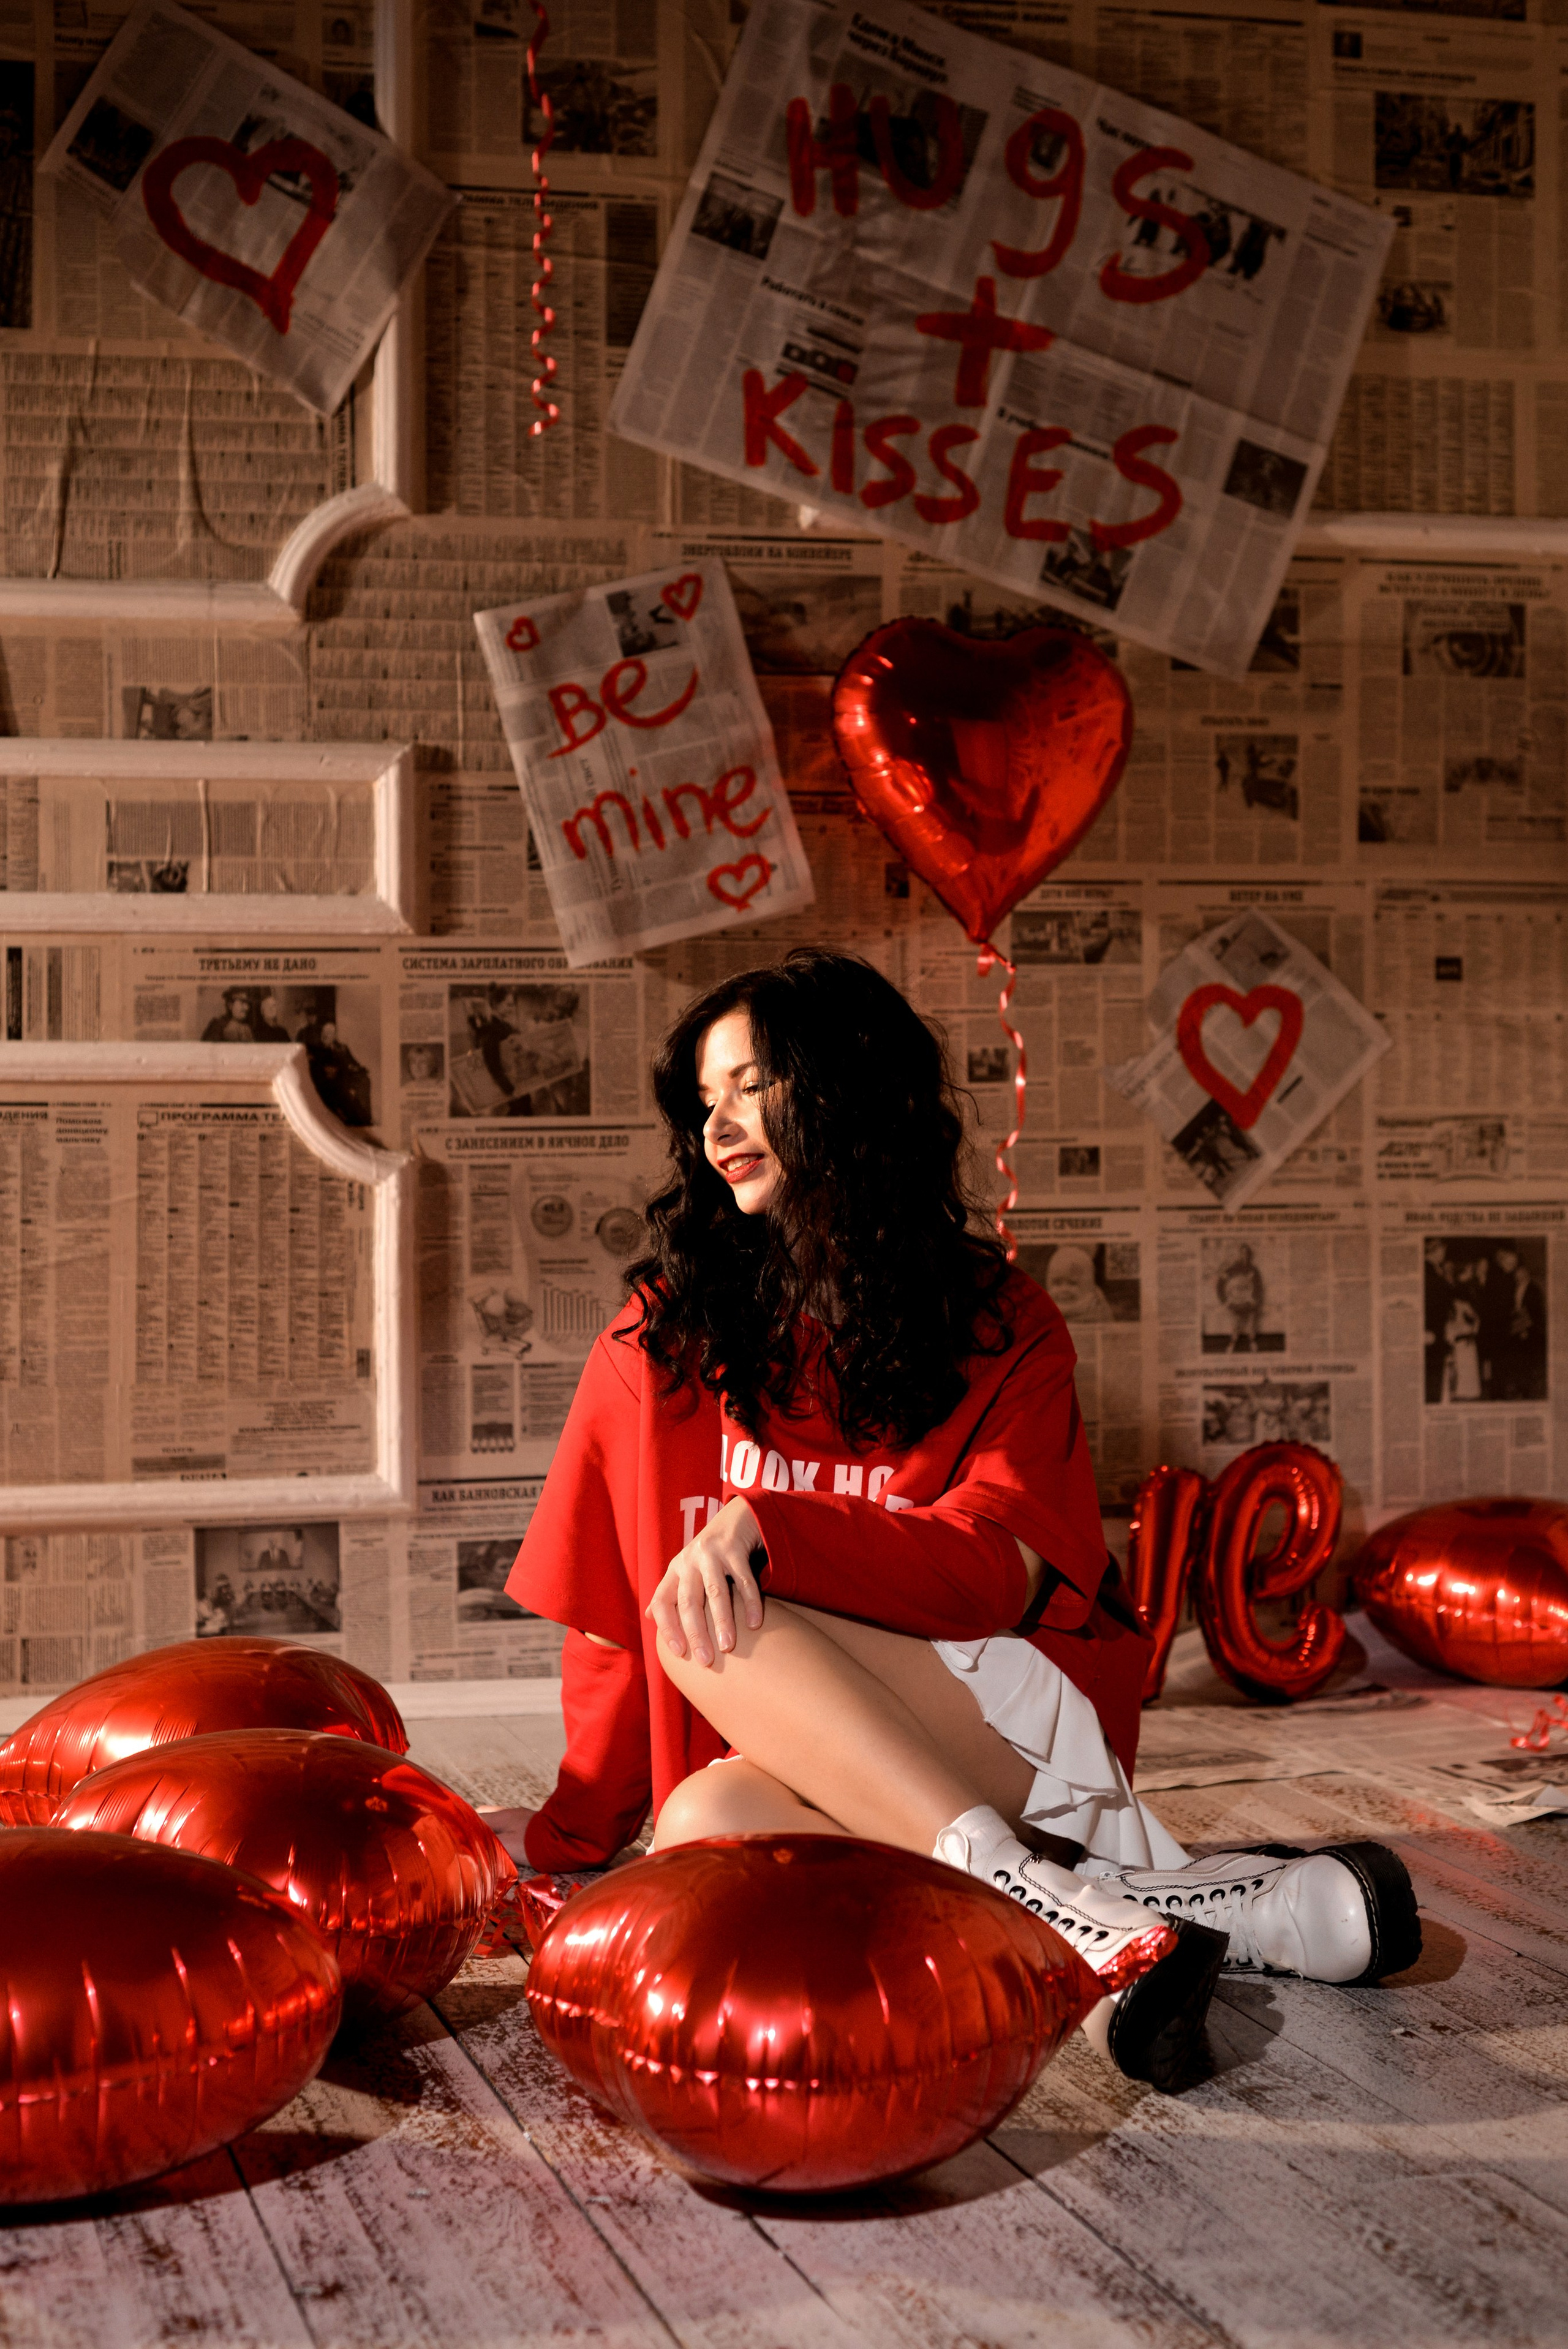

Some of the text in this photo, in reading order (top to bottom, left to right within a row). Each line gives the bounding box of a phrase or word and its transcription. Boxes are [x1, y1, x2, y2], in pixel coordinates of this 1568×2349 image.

[562, 764, 773, 861] mine
[198, 958, 317, 971] ТРЕТЬЕМУ НЕ ДАНО
[402, 957, 457, 970] СИСТЕМА
[460, 957, 546, 970] ЗАРПЛАТНОГО
[160, 1112, 260, 1122] ПРОГРАММА
[445, 1138, 453, 1150] С
[455, 1137, 534, 1150] ЗАНЕСЕНИЕМ
[538, 1137, 545, 1148] В
[598, 1135, 630, 1148] ДЕЛО
[432, 1490, 455, 1503] КАК
